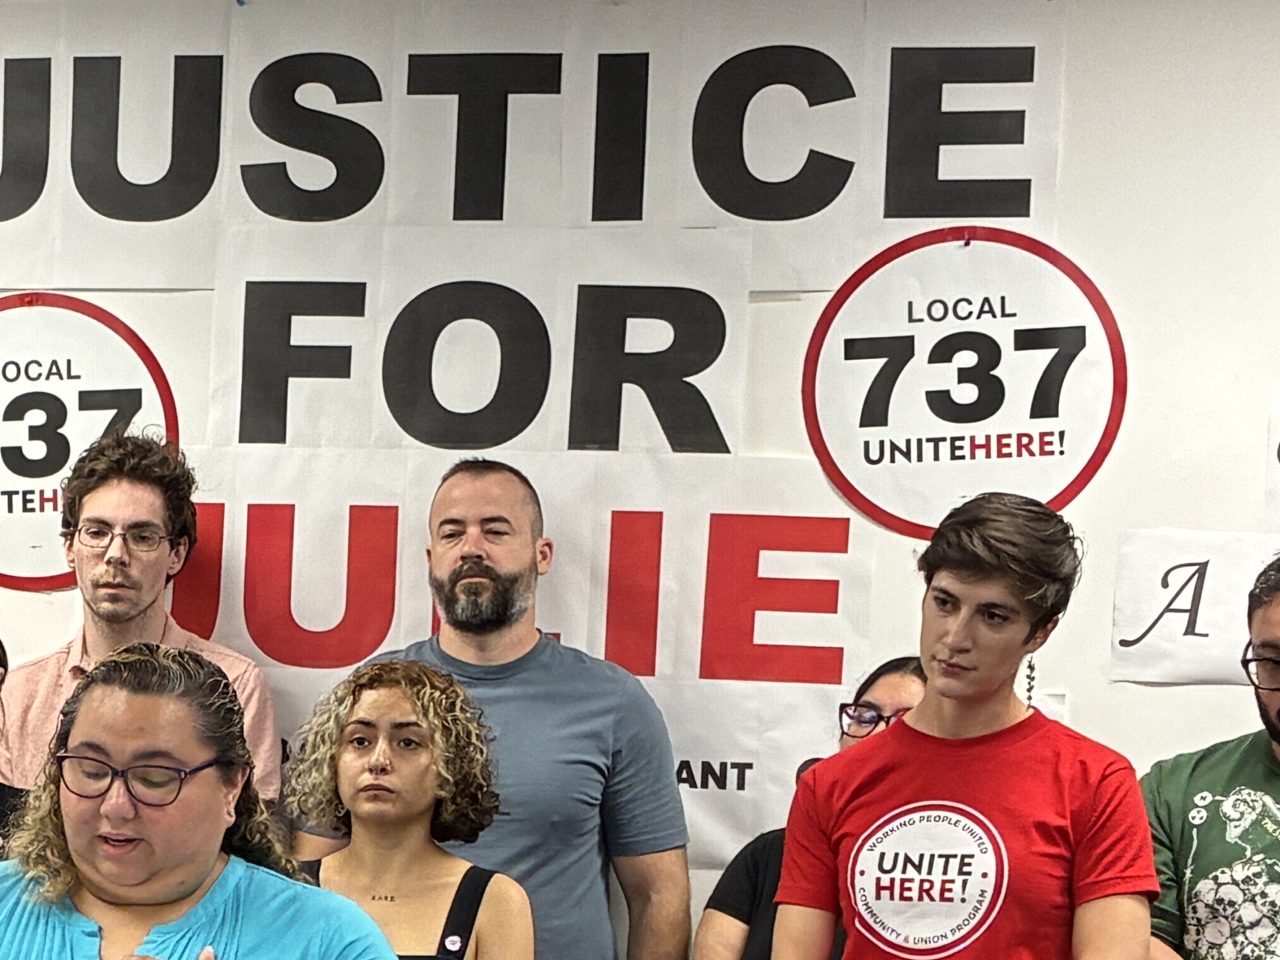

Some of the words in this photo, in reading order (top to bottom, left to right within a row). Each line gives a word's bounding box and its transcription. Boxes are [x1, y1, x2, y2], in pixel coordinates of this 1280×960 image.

[907, 295, 1018, 323] LOCAL
[238, 279, 732, 450] FOR
[844, 325, 1087, 428] 737
[171, 502, 851, 685] JUIE
[867, 817, 916, 852] WORKING
[919, 814, 961, 829] PEOPLE
[962, 823, 989, 855] UNITED
[877, 852, 976, 877] UNITE
[874, 876, 970, 904] HERE!
[858, 887, 902, 940] COMMUNITY
[913, 932, 949, 945] UNION
[950, 888, 989, 938] PROGRAM
